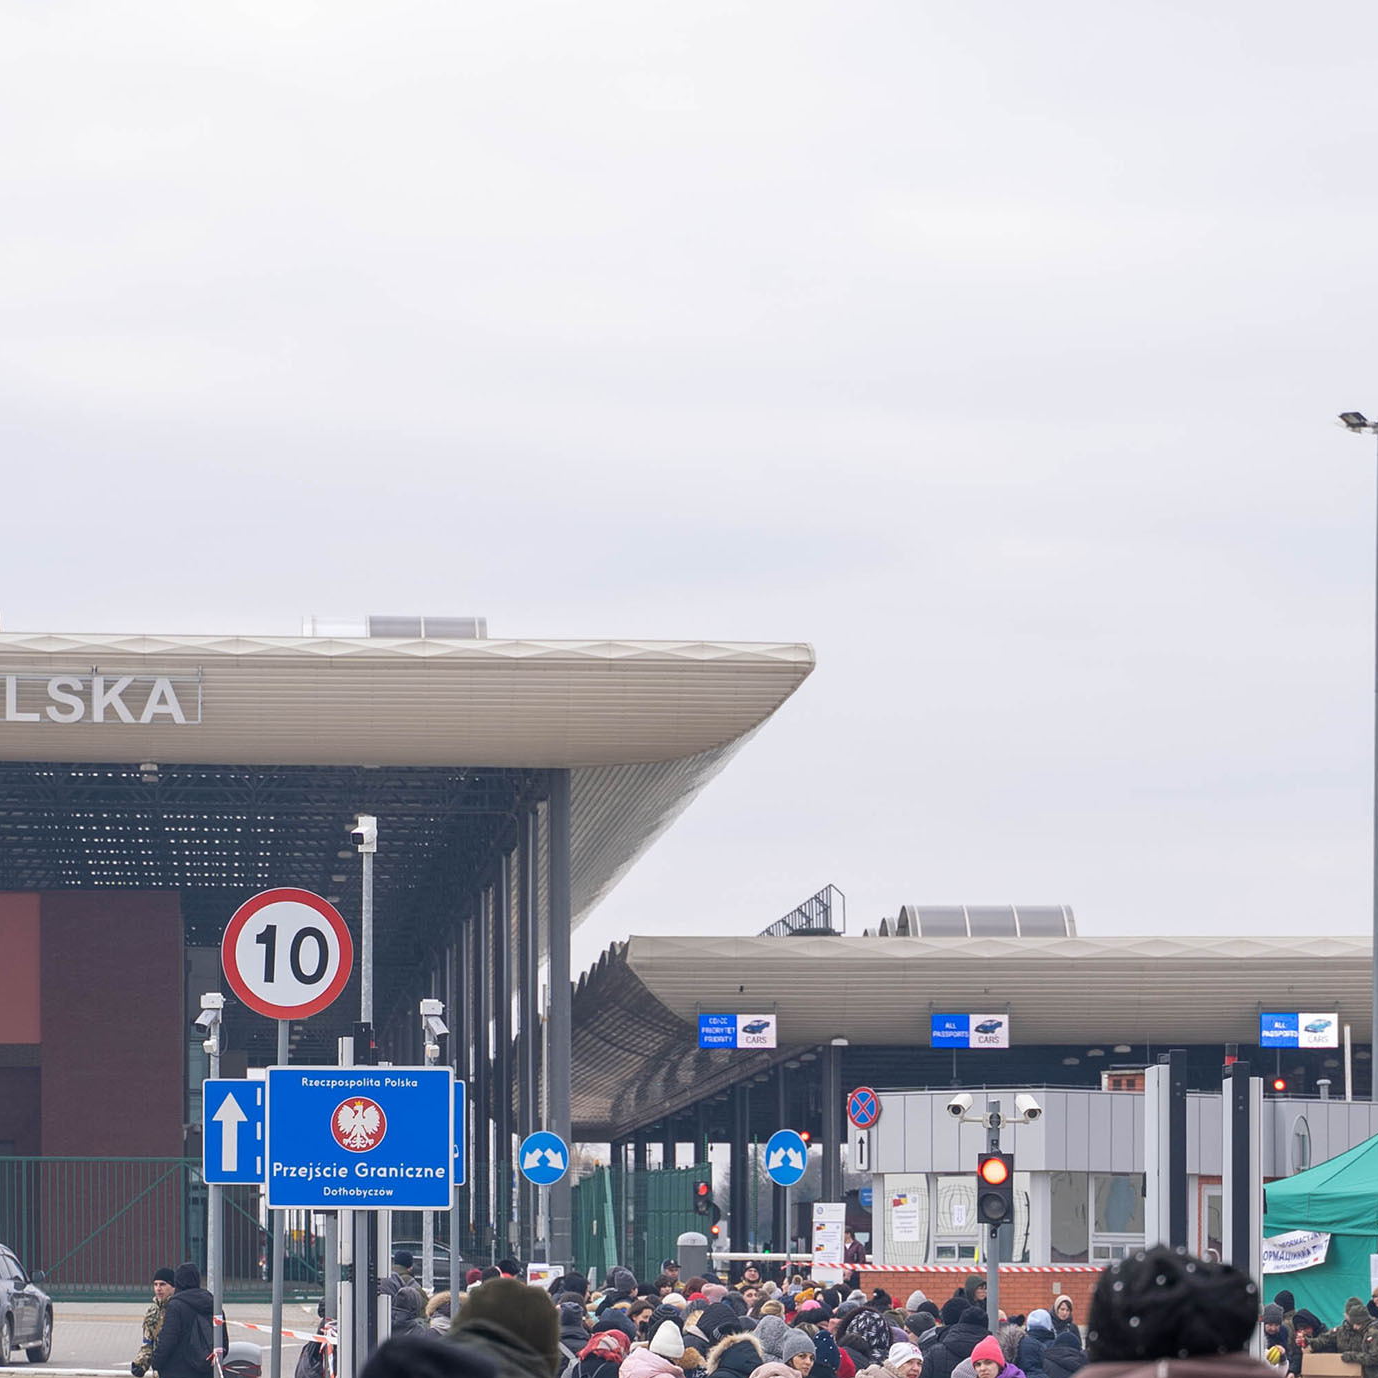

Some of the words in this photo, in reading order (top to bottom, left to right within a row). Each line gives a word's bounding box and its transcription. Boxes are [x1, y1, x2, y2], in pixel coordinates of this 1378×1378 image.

[255, 924, 329, 985] 10
[745, 1036, 767, 1044] CARS
[978, 1035, 1000, 1044] CARS
[301, 1077, 381, 1089] Rzeczpospolita
[384, 1078, 418, 1088] Polska
[272, 1162, 348, 1181] Przejście
[354, 1162, 445, 1178] Graniczne
[323, 1186, 393, 1198] Dołhobyczów
